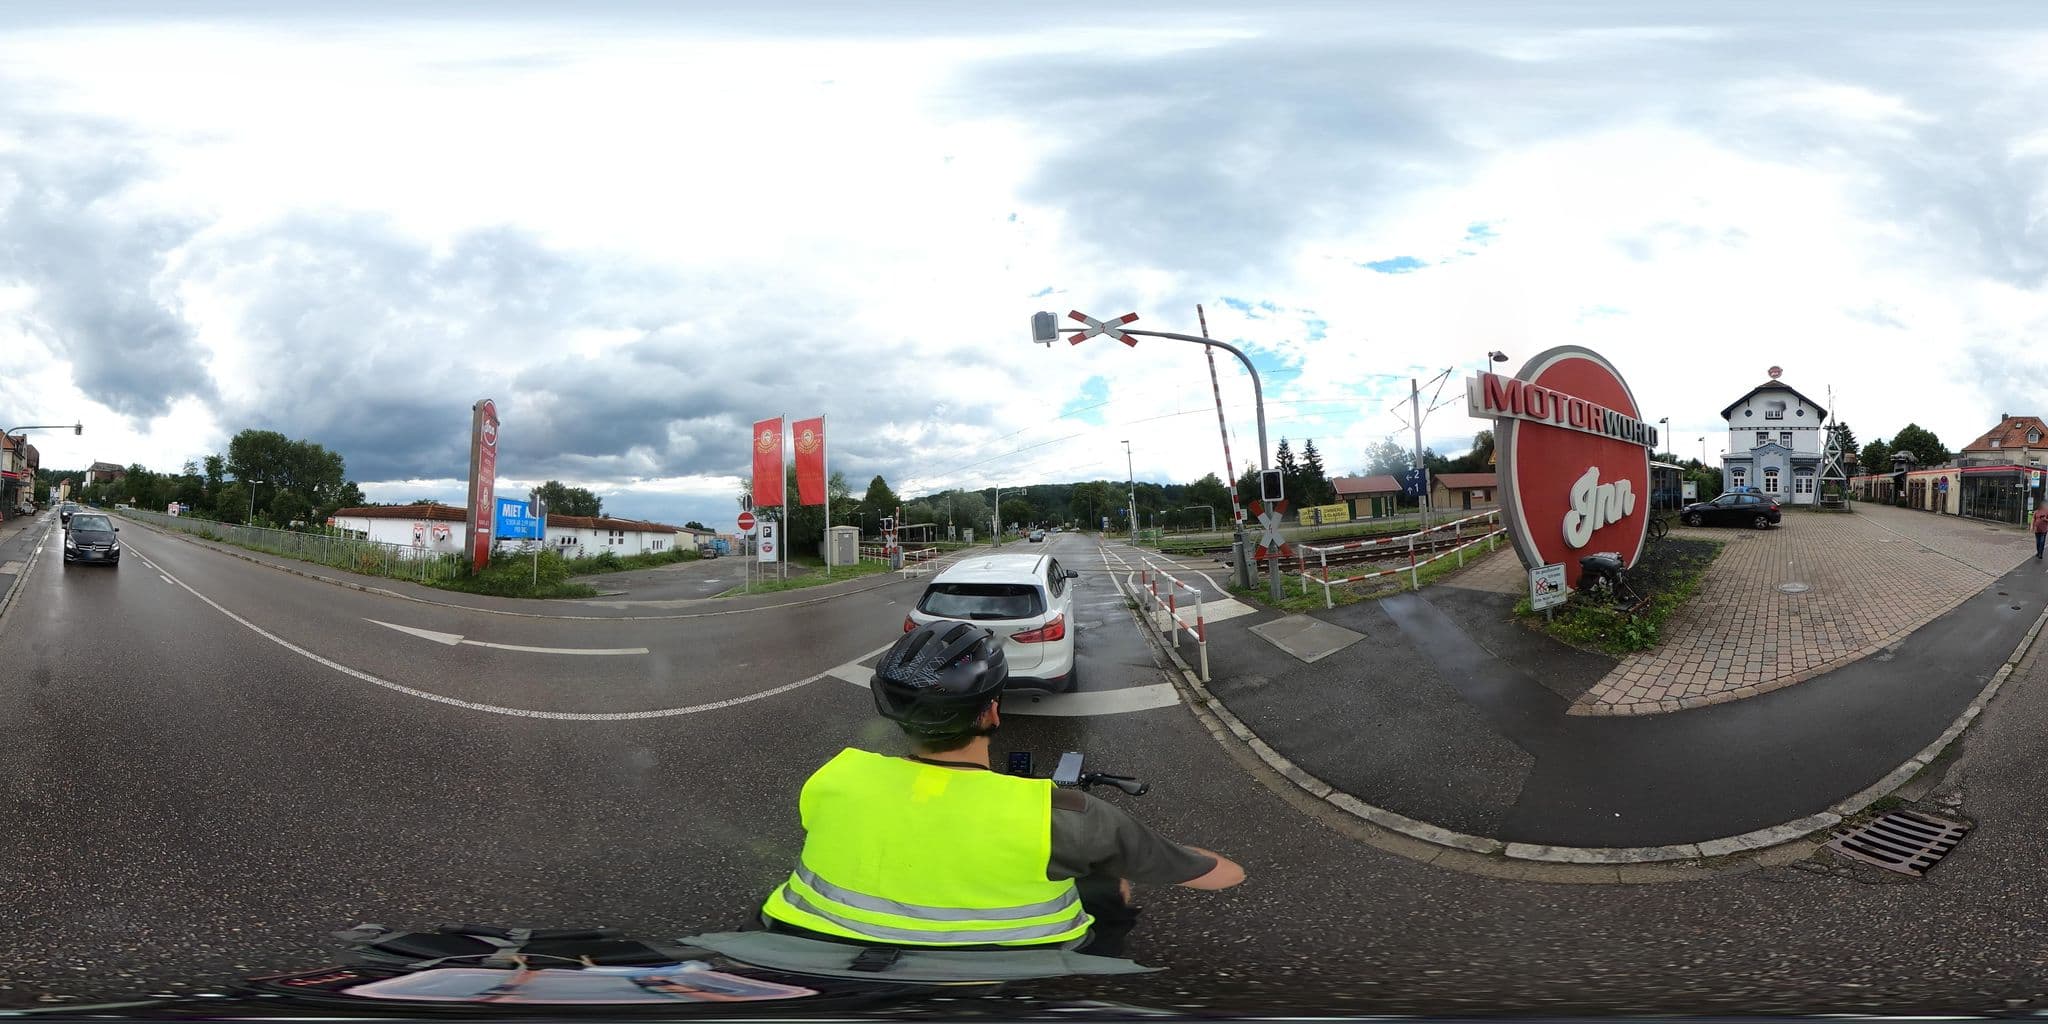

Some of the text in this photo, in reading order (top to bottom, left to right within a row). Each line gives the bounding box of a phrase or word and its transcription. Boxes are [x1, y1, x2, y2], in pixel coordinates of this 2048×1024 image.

[1483, 373, 1658, 447] MOTORWORLD
[1414, 469, 1420, 479] 2
[1563, 466, 1635, 548] Inn
[764, 527, 771, 537] P
